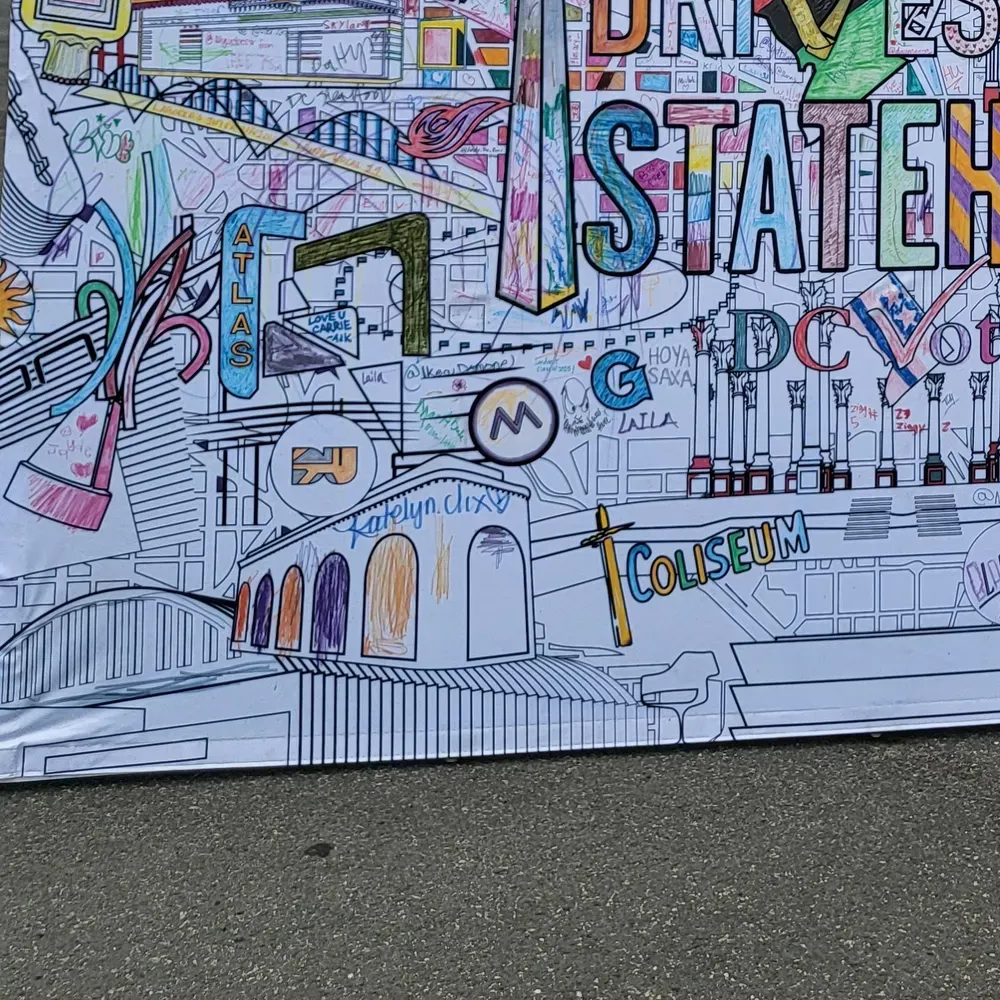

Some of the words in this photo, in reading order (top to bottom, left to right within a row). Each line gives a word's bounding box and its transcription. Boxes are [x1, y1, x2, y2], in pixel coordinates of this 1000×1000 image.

[228, 222, 255, 367] ATLAS
[308, 311, 336, 325] LOVE
[727, 306, 850, 372] DC
[647, 365, 697, 388] SAXA
[648, 346, 692, 367] HOYA
[591, 348, 652, 410] G
[617, 411, 679, 434] LAILA
[625, 510, 811, 603] COLISEUM
